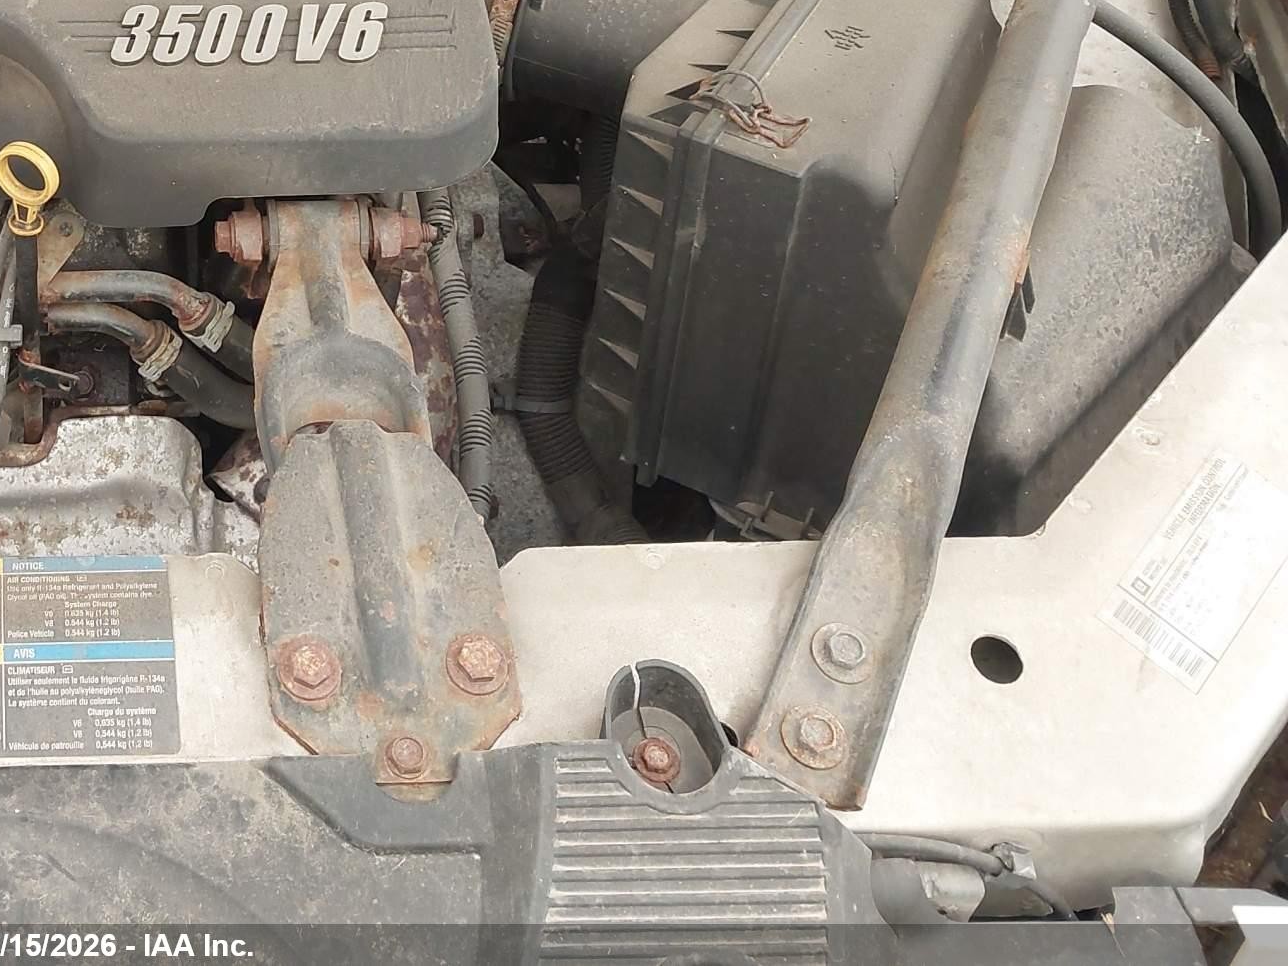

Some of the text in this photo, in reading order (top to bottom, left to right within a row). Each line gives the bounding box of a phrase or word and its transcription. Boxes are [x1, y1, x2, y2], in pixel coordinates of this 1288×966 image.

[111, 1, 389, 66] 3500 V6
[12, 562, 44, 570] NOTICE
[14, 648, 35, 659] AVIS
